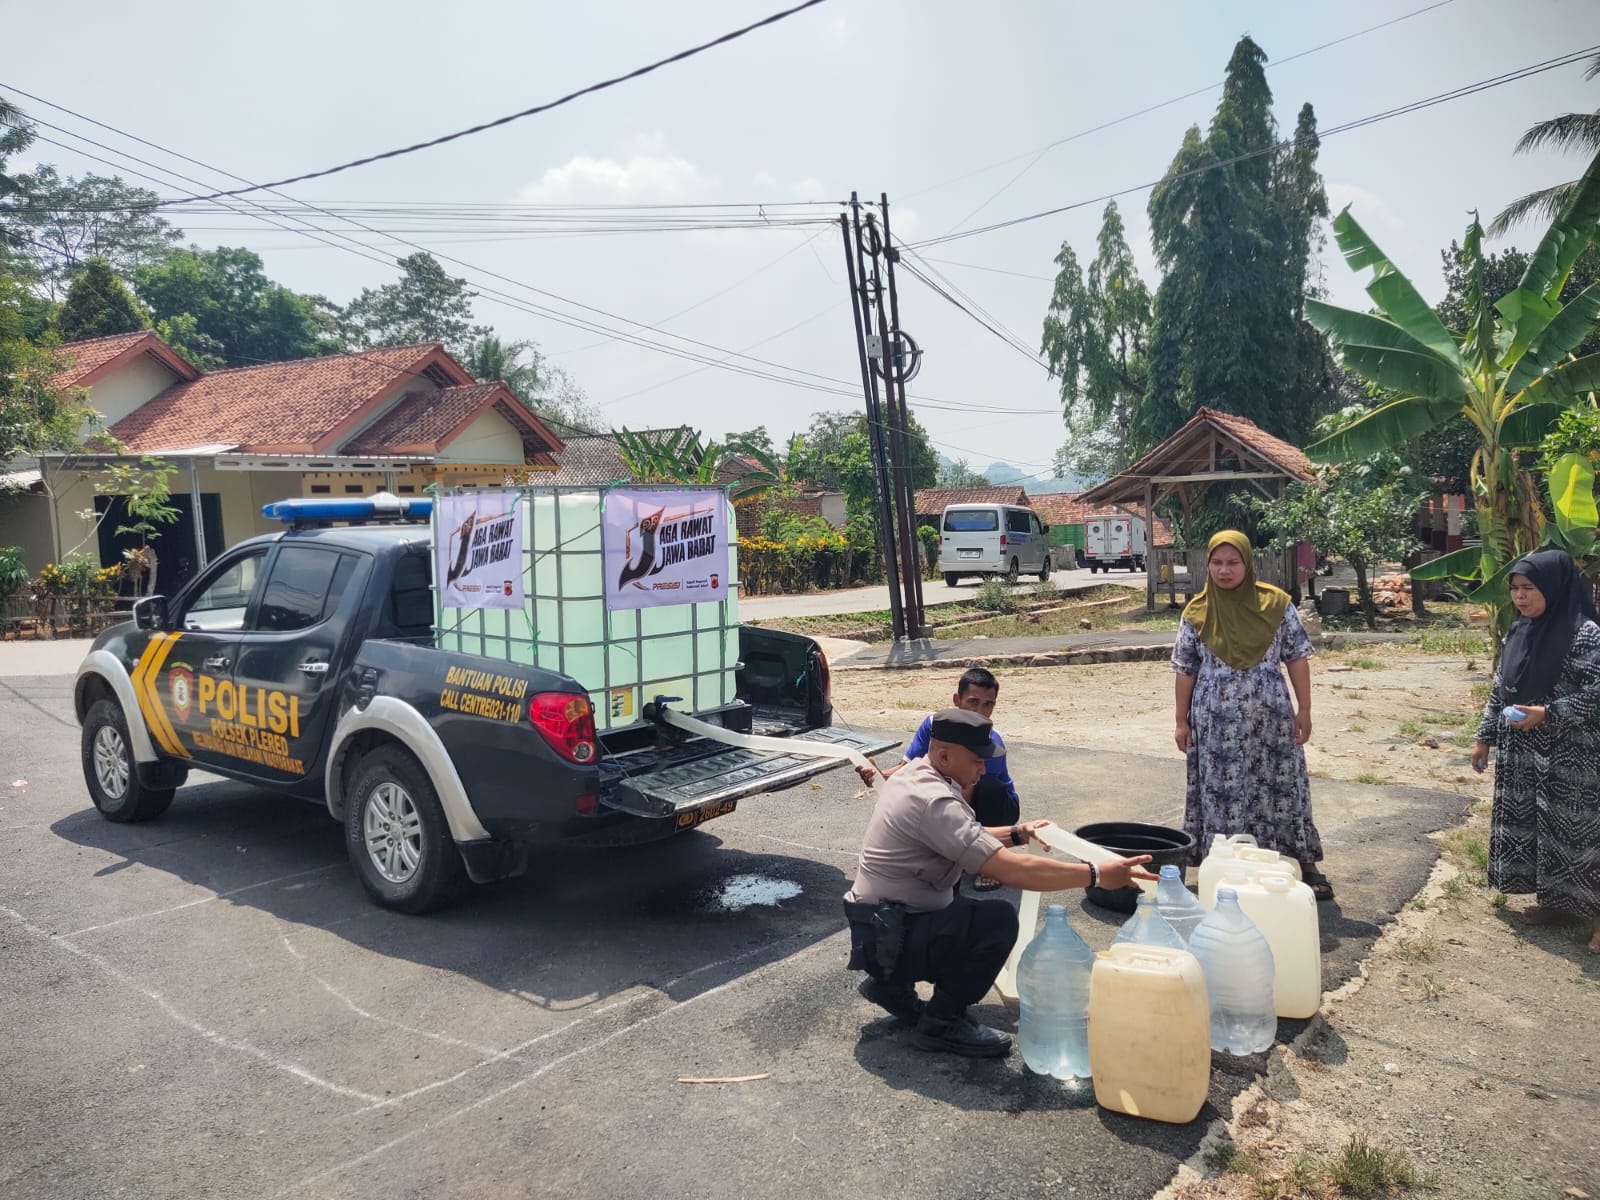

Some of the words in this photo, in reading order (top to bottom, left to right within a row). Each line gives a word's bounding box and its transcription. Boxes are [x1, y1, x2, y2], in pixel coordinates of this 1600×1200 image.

[488, 518, 515, 544] RAWAT
[681, 515, 714, 540] RAWAT
[461, 546, 489, 577] JAWA
[489, 539, 514, 564] BARAT
[648, 542, 685, 576] JAWA
[687, 535, 716, 560] BARAT
[440, 688, 459, 710] CALL
[446, 666, 494, 691] BANTUAN
[492, 675, 528, 699] POLISI
[198, 674, 299, 737] POLISI
[210, 717, 249, 747] POLSEK
[249, 727, 289, 756] PLERED
